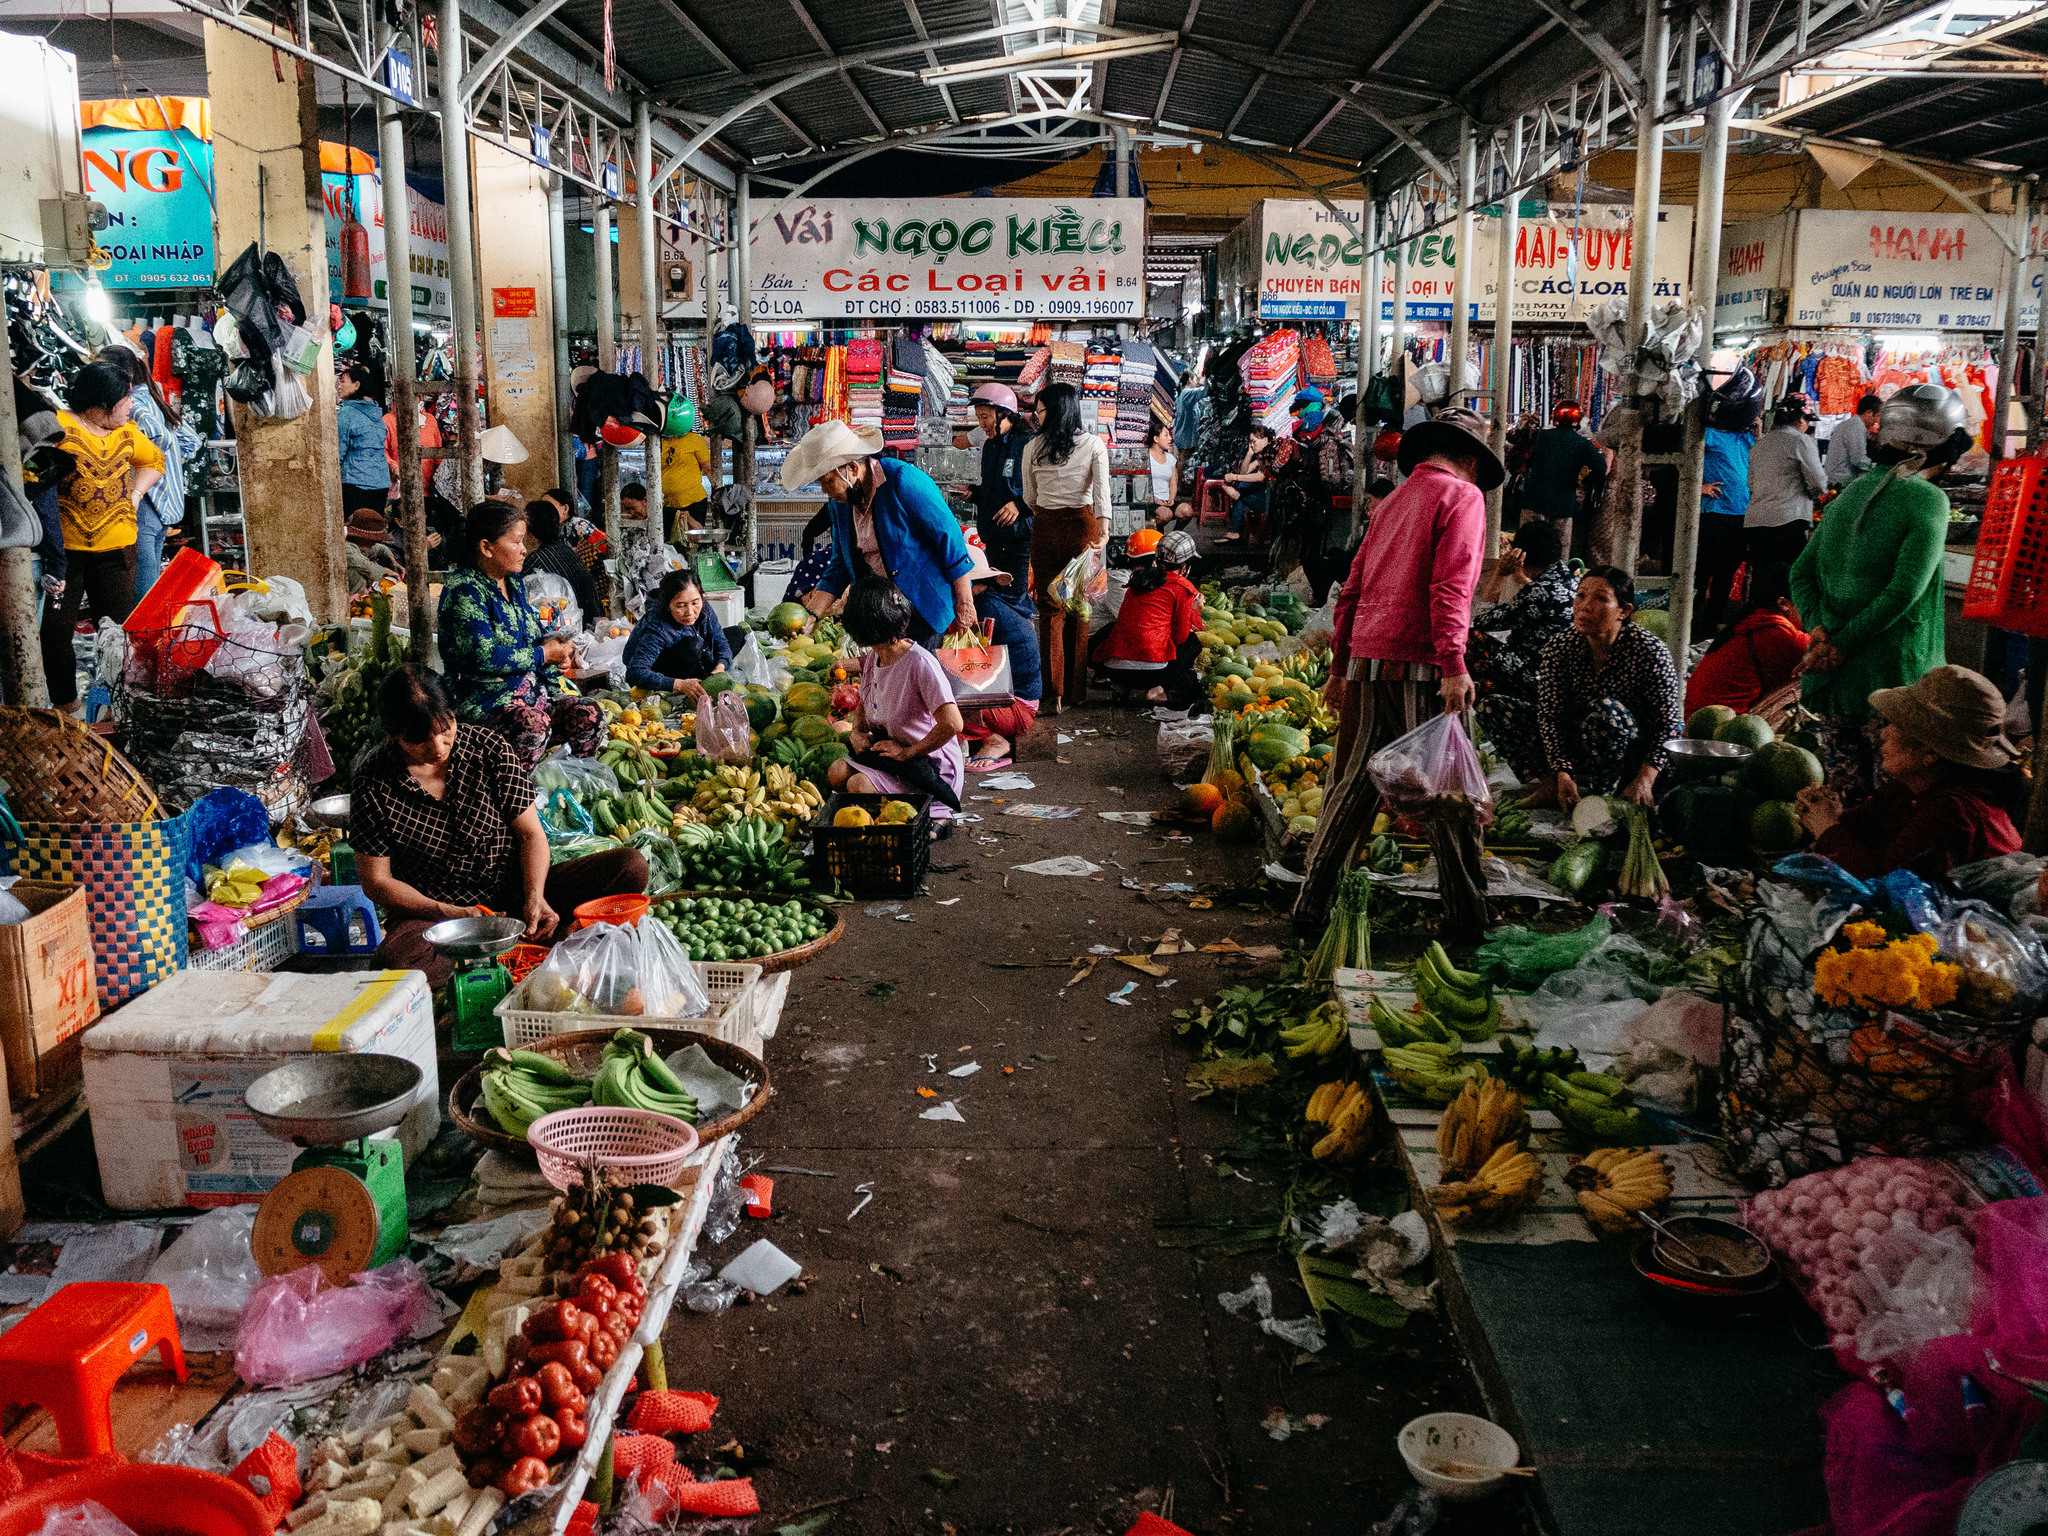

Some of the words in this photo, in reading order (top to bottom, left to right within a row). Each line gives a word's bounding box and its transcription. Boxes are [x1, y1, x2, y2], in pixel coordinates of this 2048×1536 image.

[152, 239, 204, 264] NHẬP
[171, 274, 189, 283] 632
[822, 269, 910, 292] Các
[927, 270, 1023, 296] Loại
[1040, 266, 1107, 292] vải
[1116, 276, 1138, 288] B.64
[774, 300, 804, 315] LOA
[914, 300, 1000, 315] 0583.511006
[1048, 299, 1135, 315] 0909.196007
